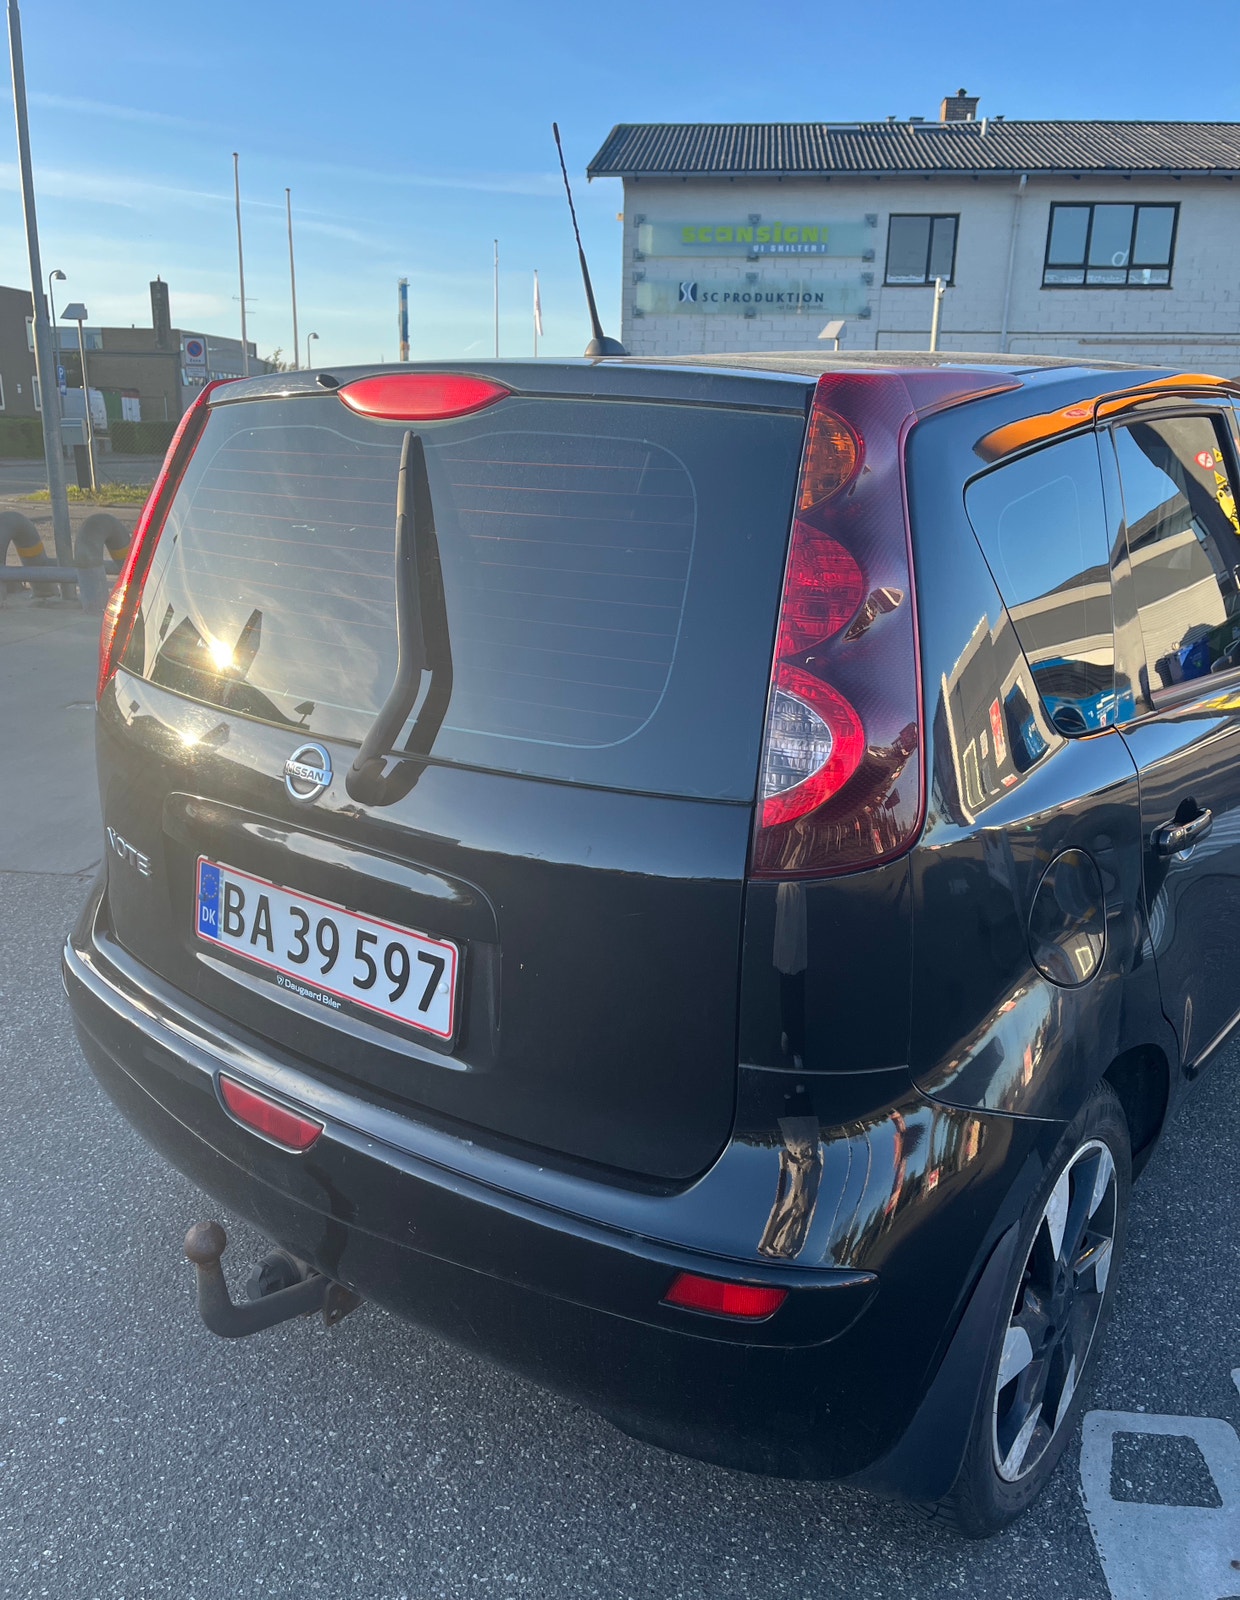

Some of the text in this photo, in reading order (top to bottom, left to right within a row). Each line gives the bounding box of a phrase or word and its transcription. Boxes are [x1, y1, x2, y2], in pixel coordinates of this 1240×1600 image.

[702, 292, 825, 303] SC PRODUKTION
[286, 761, 325, 783] NISSAN
[202, 905, 216, 926] DK
[223, 881, 446, 1013] BA 39 597
[285, 978, 342, 1009] Daugaard Biler
